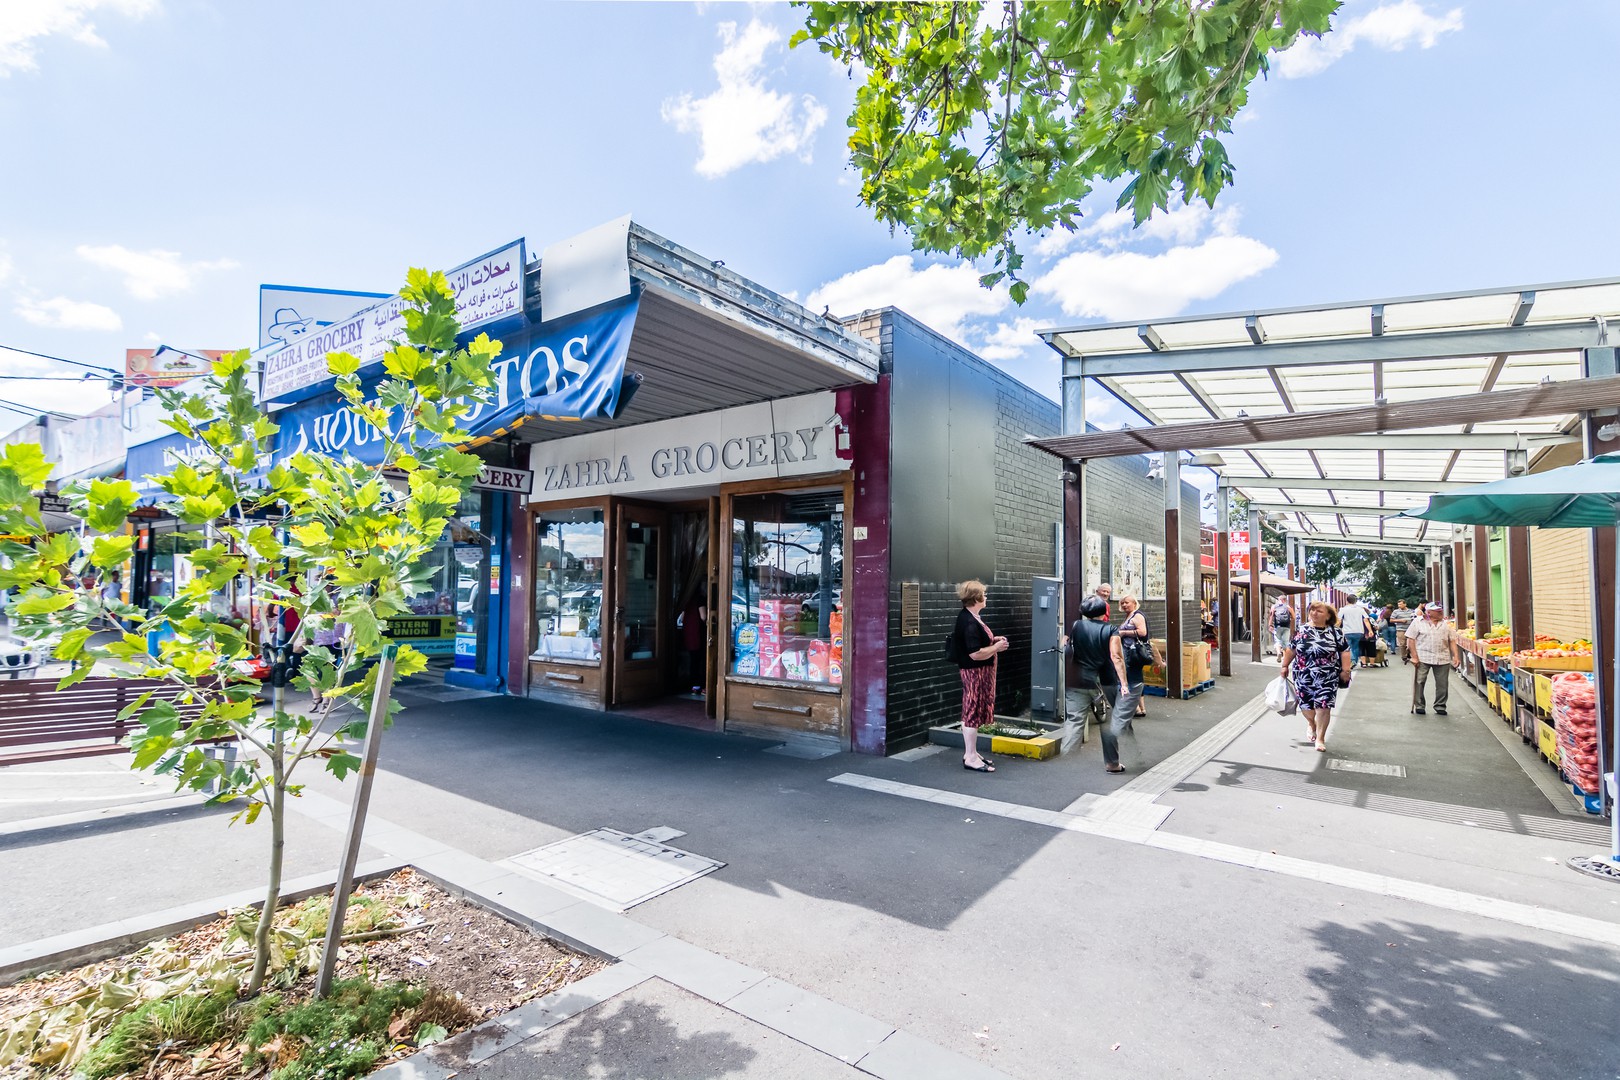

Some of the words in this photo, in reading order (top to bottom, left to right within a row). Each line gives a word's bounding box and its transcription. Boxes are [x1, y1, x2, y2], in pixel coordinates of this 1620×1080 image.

[471, 261, 511, 286] محلات
[267, 345, 303, 376] ZAHRA
[307, 317, 365, 360] GROCERY
[545, 456, 634, 490] ZAHRA
[651, 427, 823, 478] GROCERY
[477, 471, 526, 493] CERY
[388, 620, 429, 629] ESTERN
[394, 628, 429, 636] UNION
